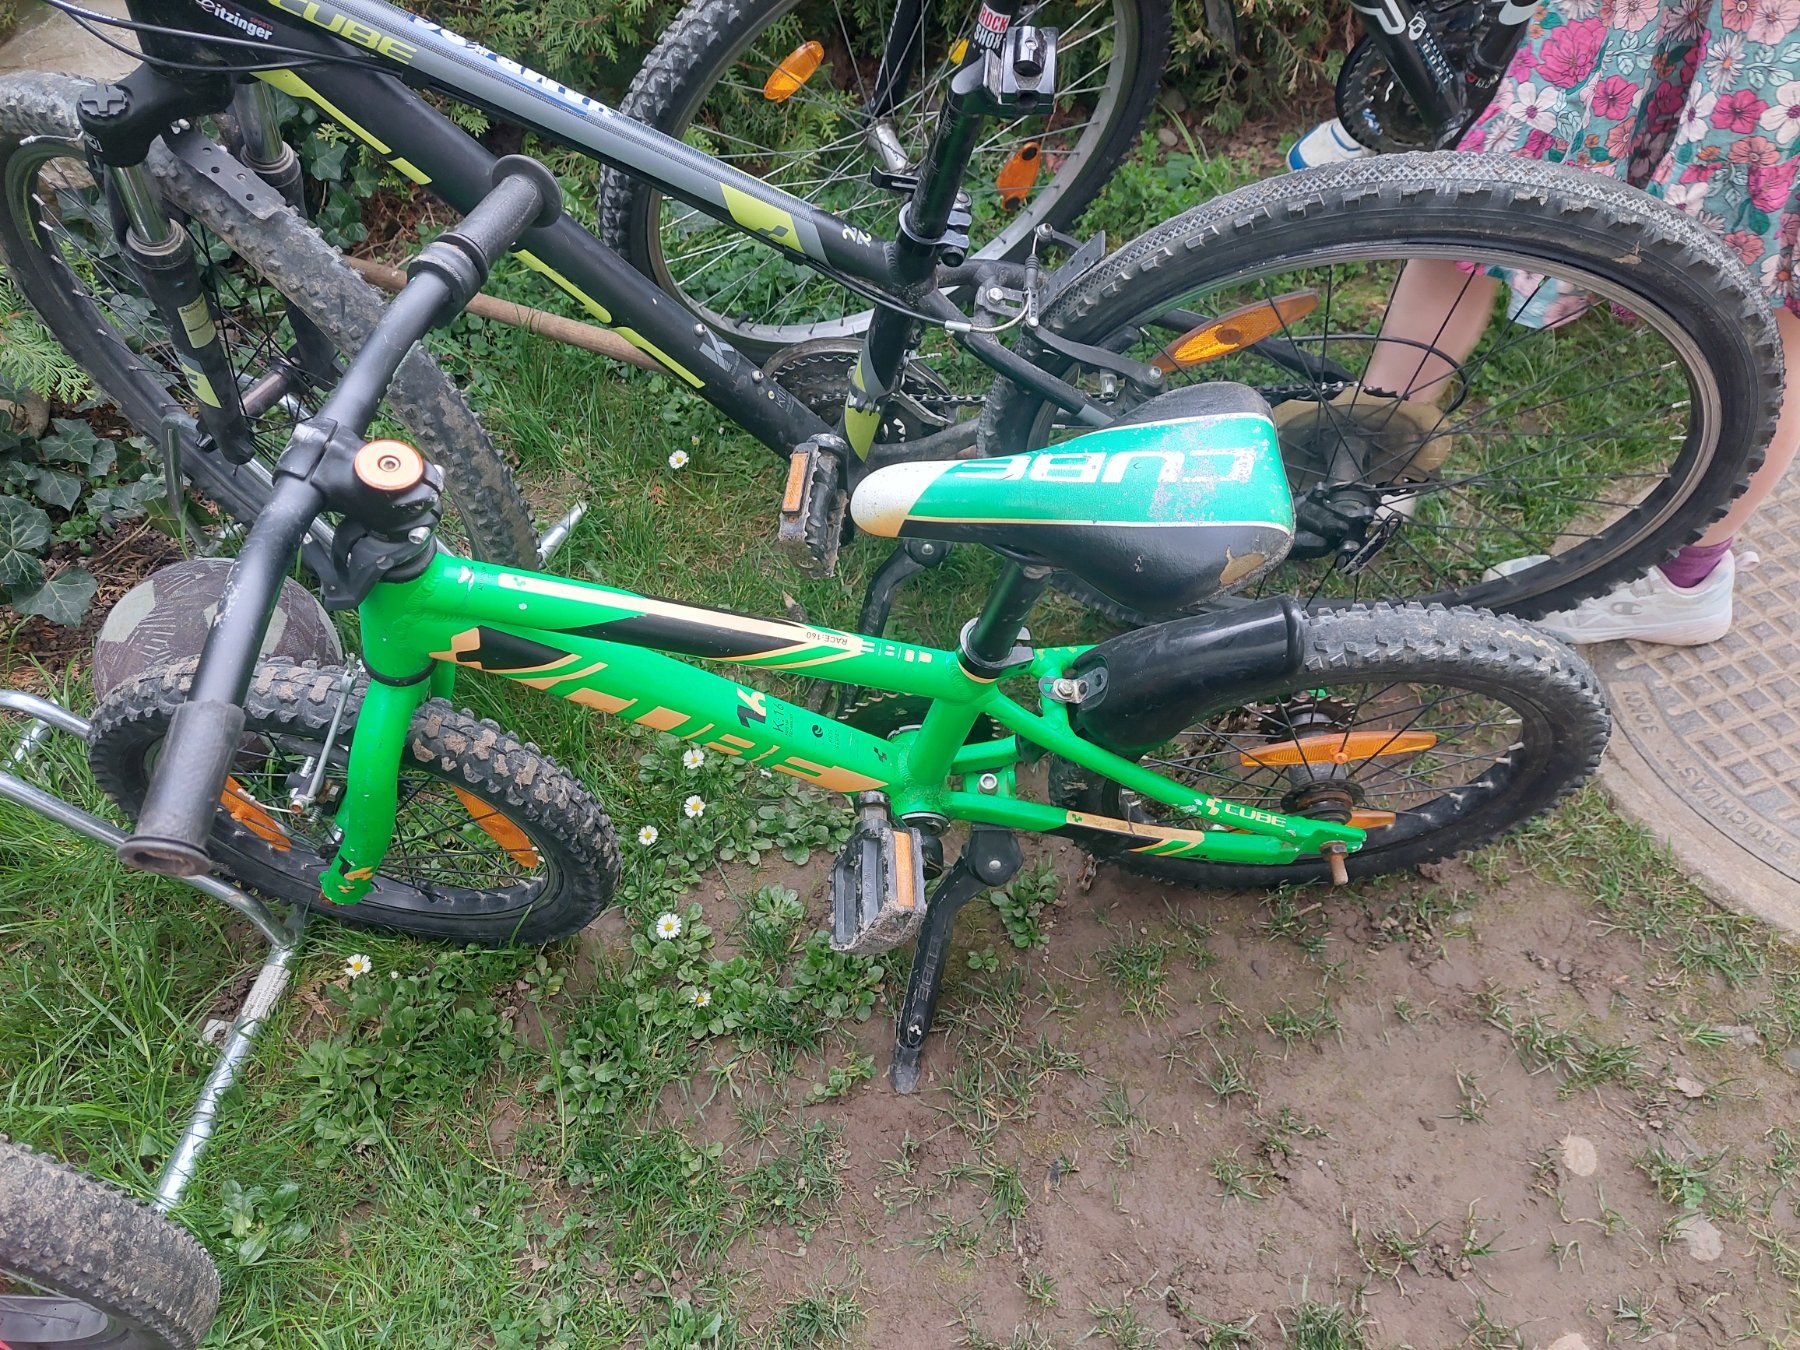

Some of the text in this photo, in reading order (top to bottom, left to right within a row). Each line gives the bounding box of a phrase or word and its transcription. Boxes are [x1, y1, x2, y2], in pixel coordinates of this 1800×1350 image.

[979, 6, 1009, 32] ROCK
[973, 22, 1003, 49] SHOX
[953, 447, 1256, 484] CUBE
[806, 631, 848, 646] RACE:160
[1225, 803, 1287, 828] CUBE
